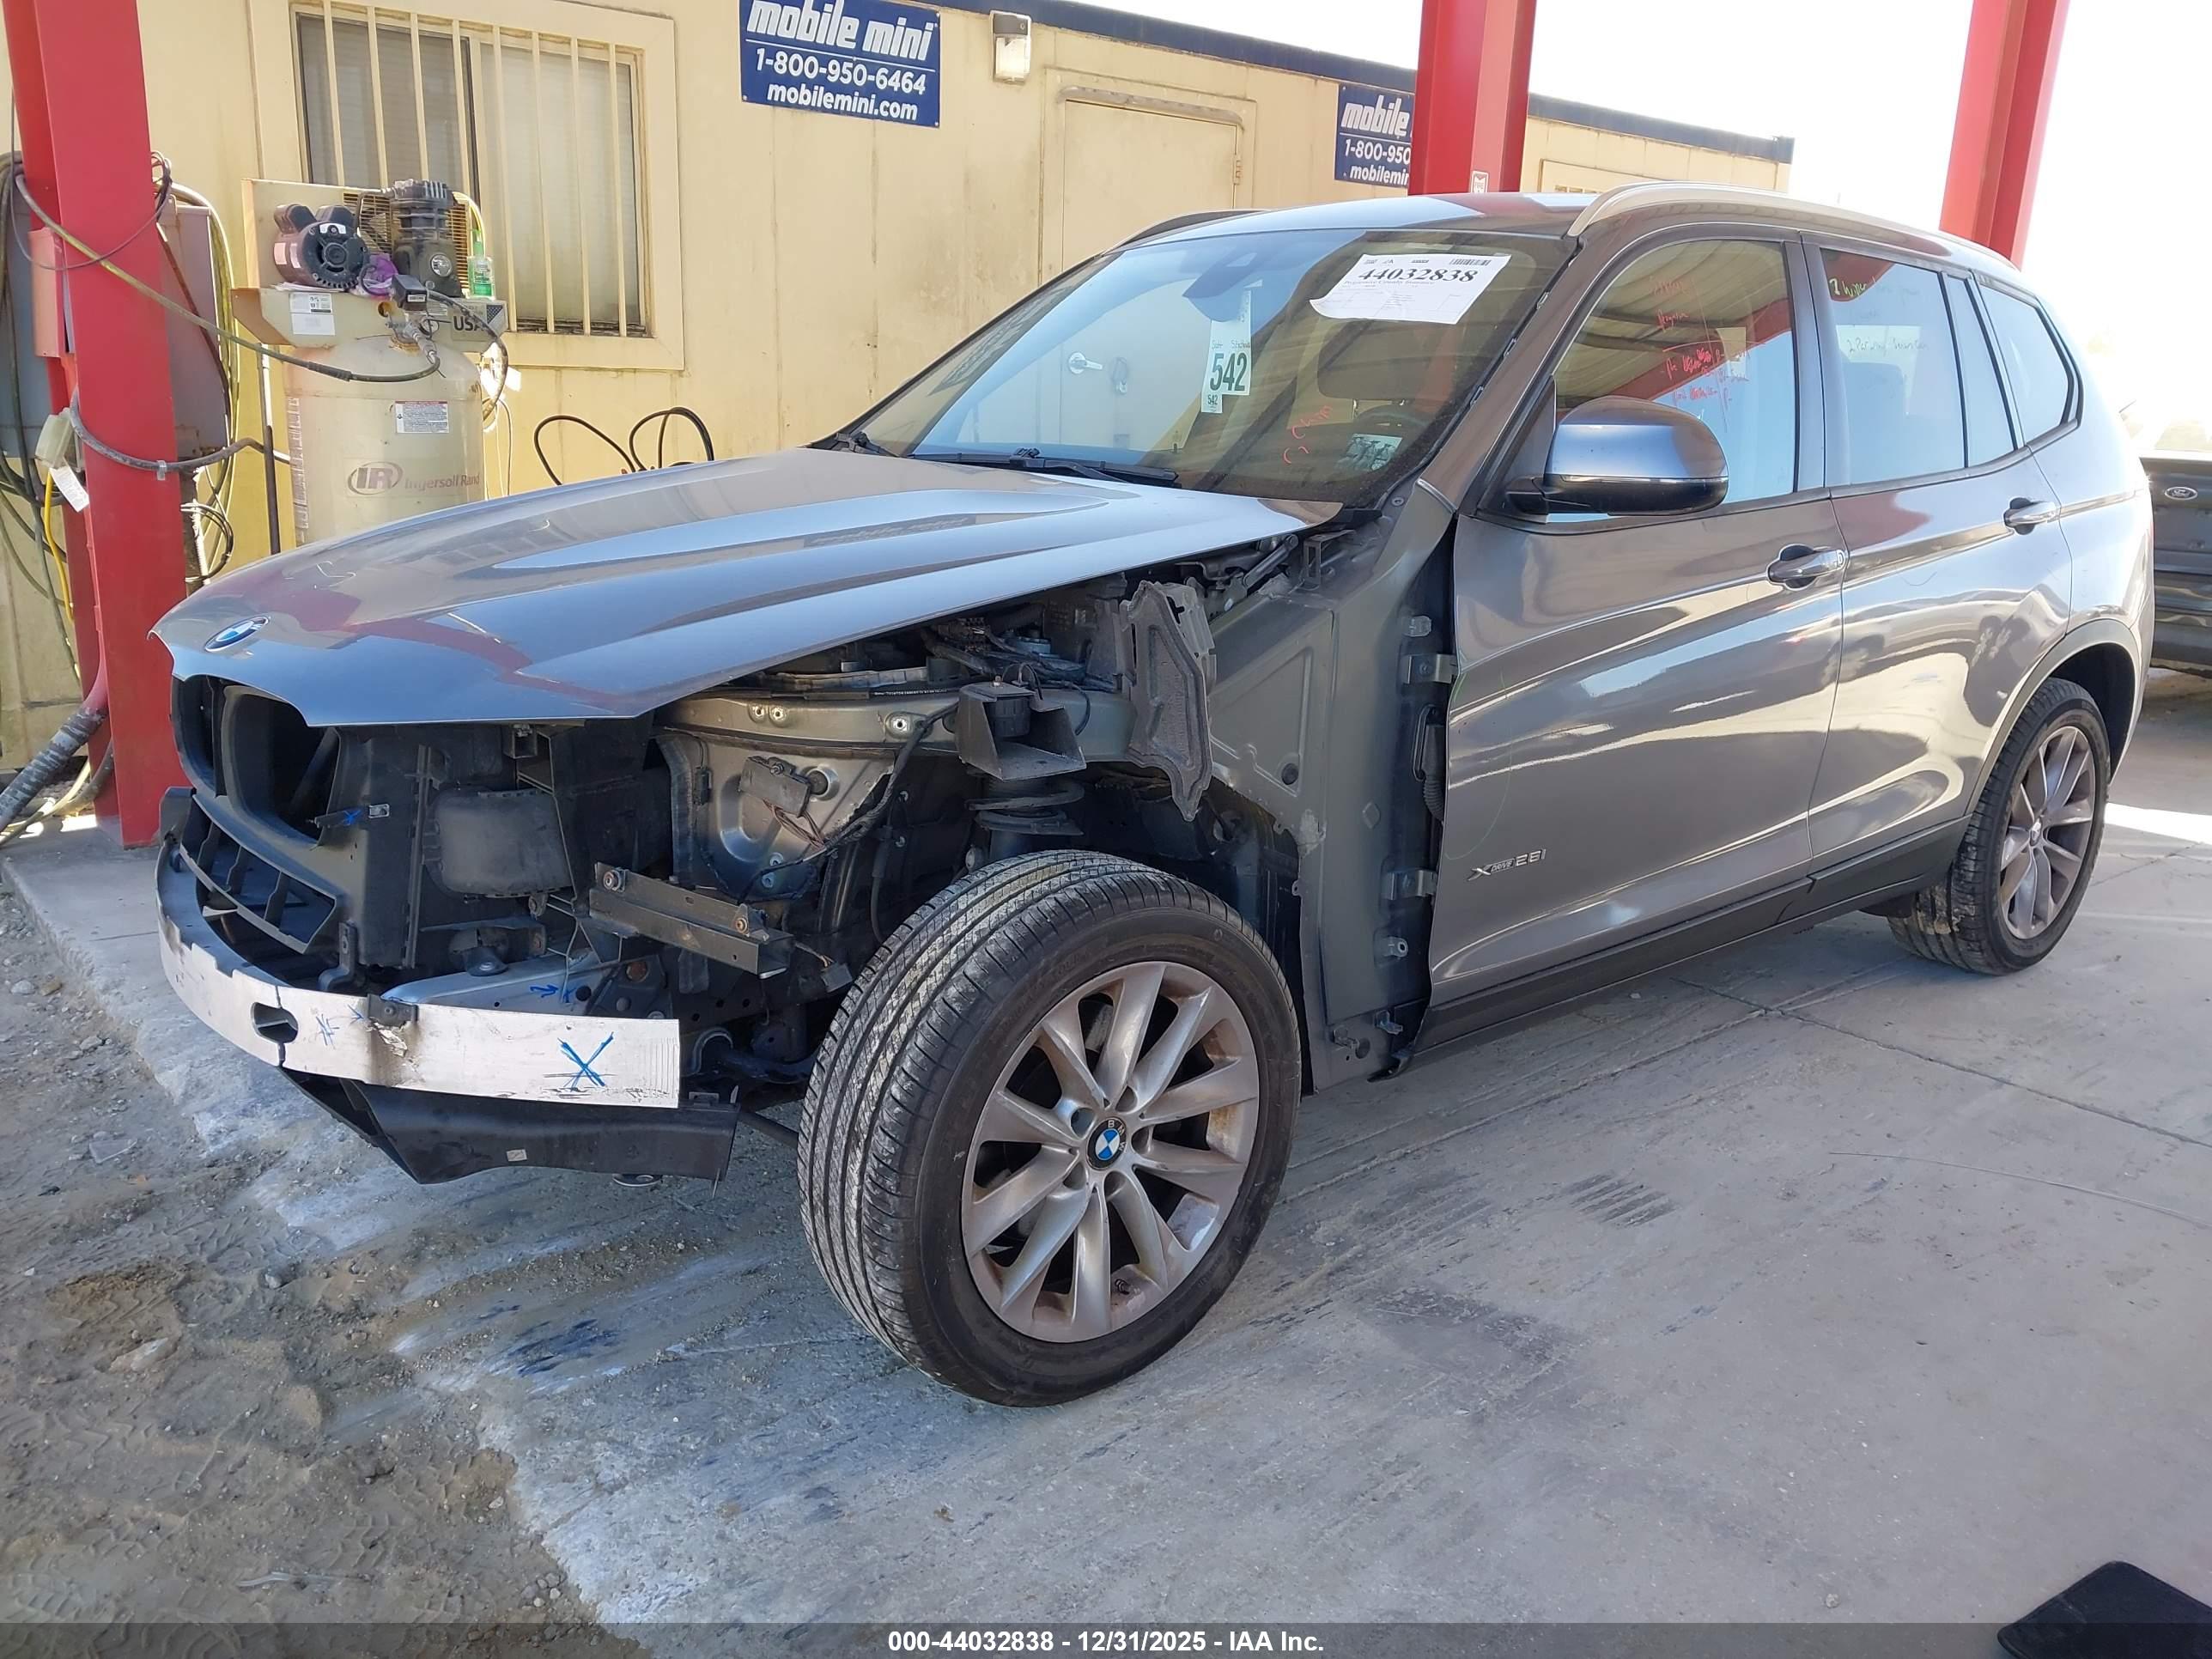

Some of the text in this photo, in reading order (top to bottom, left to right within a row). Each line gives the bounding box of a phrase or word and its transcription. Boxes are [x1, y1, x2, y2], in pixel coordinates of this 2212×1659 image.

[746, 0, 934, 61] mobile mini
[756, 47, 927, 95] 1-800-950-6464
[767, 83, 918, 121] mobilemini.com
[1340, 94, 1410, 137] mobile
[1345, 138, 1412, 165] 1-800-950
[1358, 267, 1479, 283] 44032838
[1209, 352, 1248, 392] 542
[1207, 393, 1218, 405] 542
[460, 473, 480, 487] Rand
